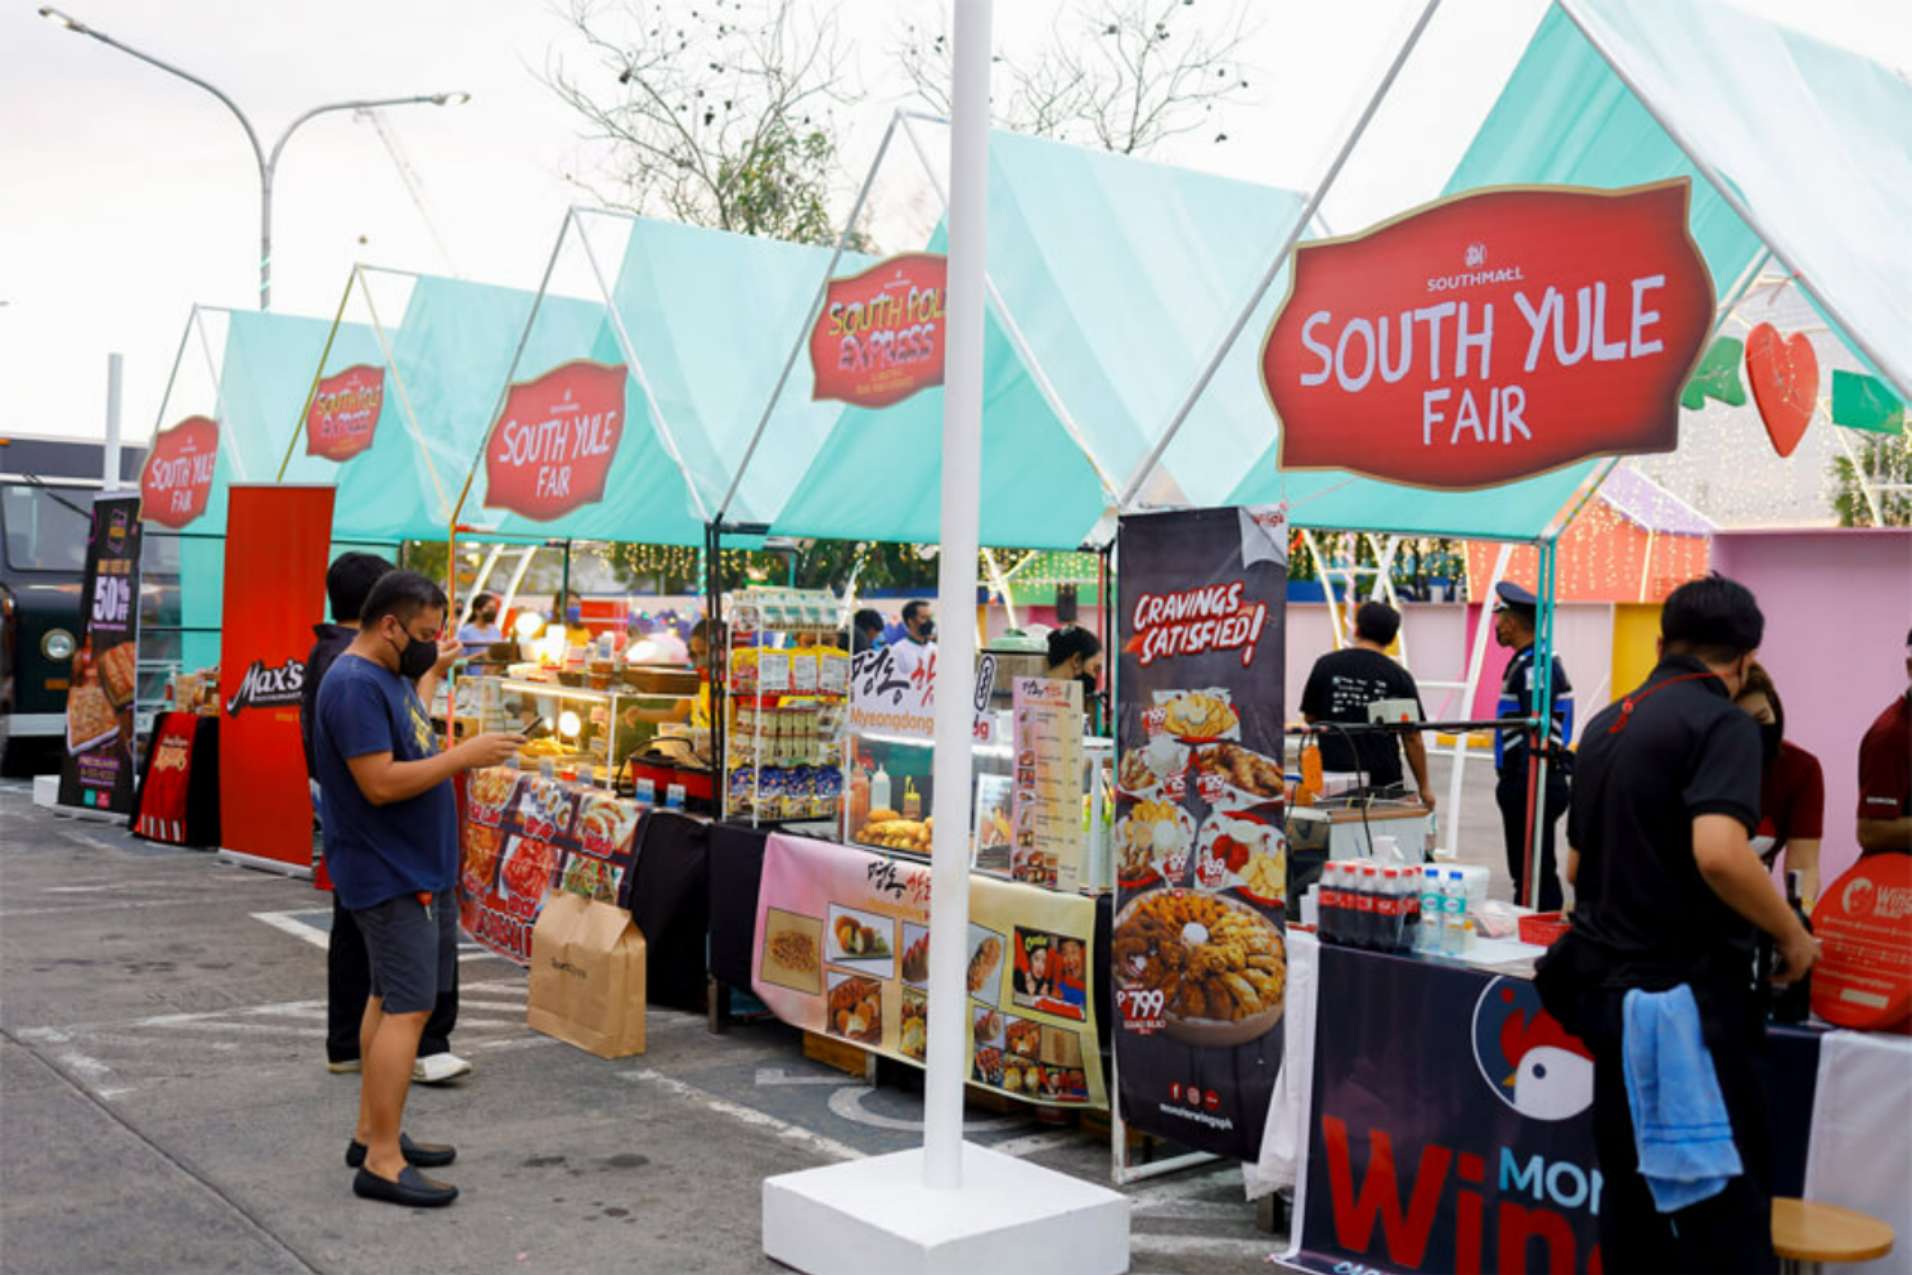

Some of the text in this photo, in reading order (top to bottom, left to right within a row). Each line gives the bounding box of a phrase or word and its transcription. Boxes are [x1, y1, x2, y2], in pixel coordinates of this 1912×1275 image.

[1427, 266, 1525, 292] SOUTHMALL
[828, 285, 946, 336] SOUTH POL
[1300, 274, 1666, 392] SOUTH YULE
[838, 322, 936, 374] EXPRESS
[317, 388, 358, 415] SOUTH
[1423, 385, 1532, 445] FAIR
[499, 410, 616, 467] SOUTH YULE
[149, 451, 217, 491] SOUTH YULE
[536, 465, 572, 498] FAIR
[170, 489, 192, 513] FAIR
[1134, 583, 1243, 630] CRAVINGS
[1140, 604, 1266, 664] SATISFIED!
[227, 659, 304, 711] Max's
[850, 708, 935, 735] Myeongdong
[1322, 1114, 1603, 1275] Win
